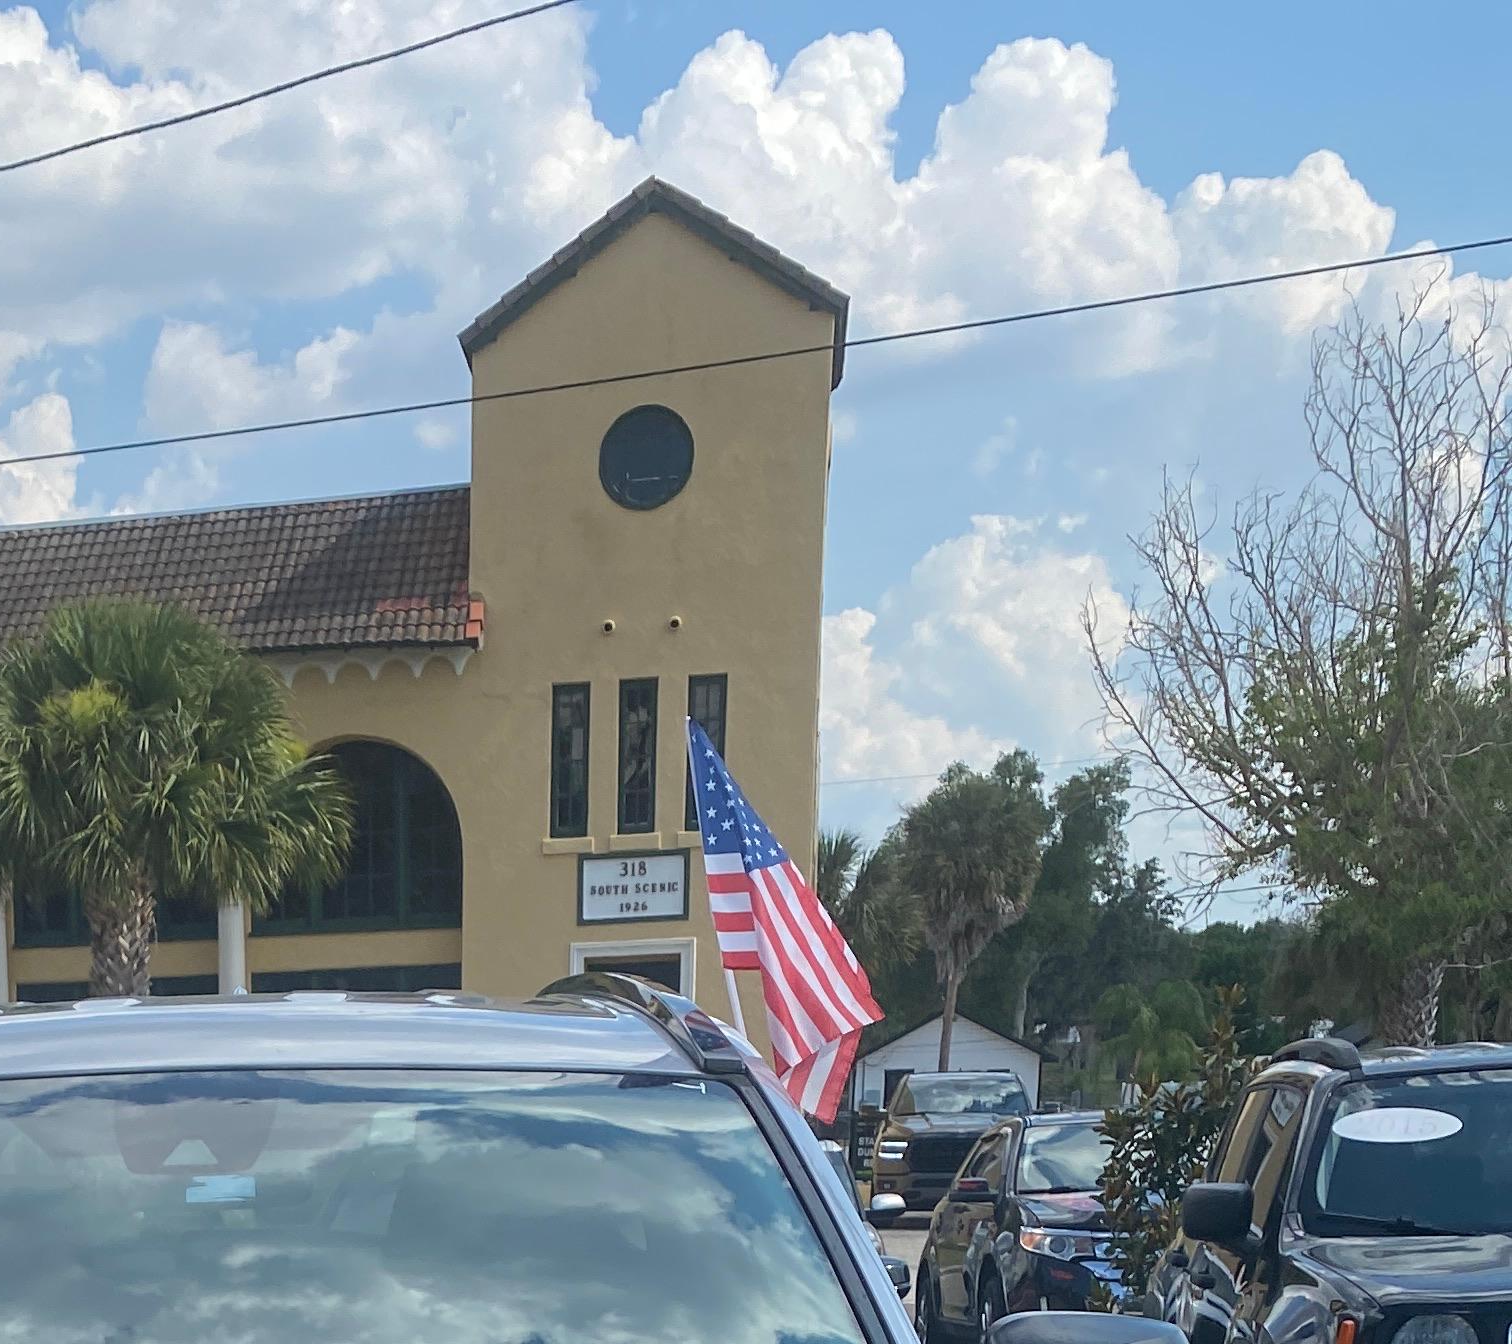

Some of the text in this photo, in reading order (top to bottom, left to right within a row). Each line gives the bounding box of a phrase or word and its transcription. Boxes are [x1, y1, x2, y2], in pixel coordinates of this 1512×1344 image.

[619, 861, 647, 877] 318
[590, 881, 679, 896] SOUTH SCENIC
[619, 902, 648, 913] 1926
